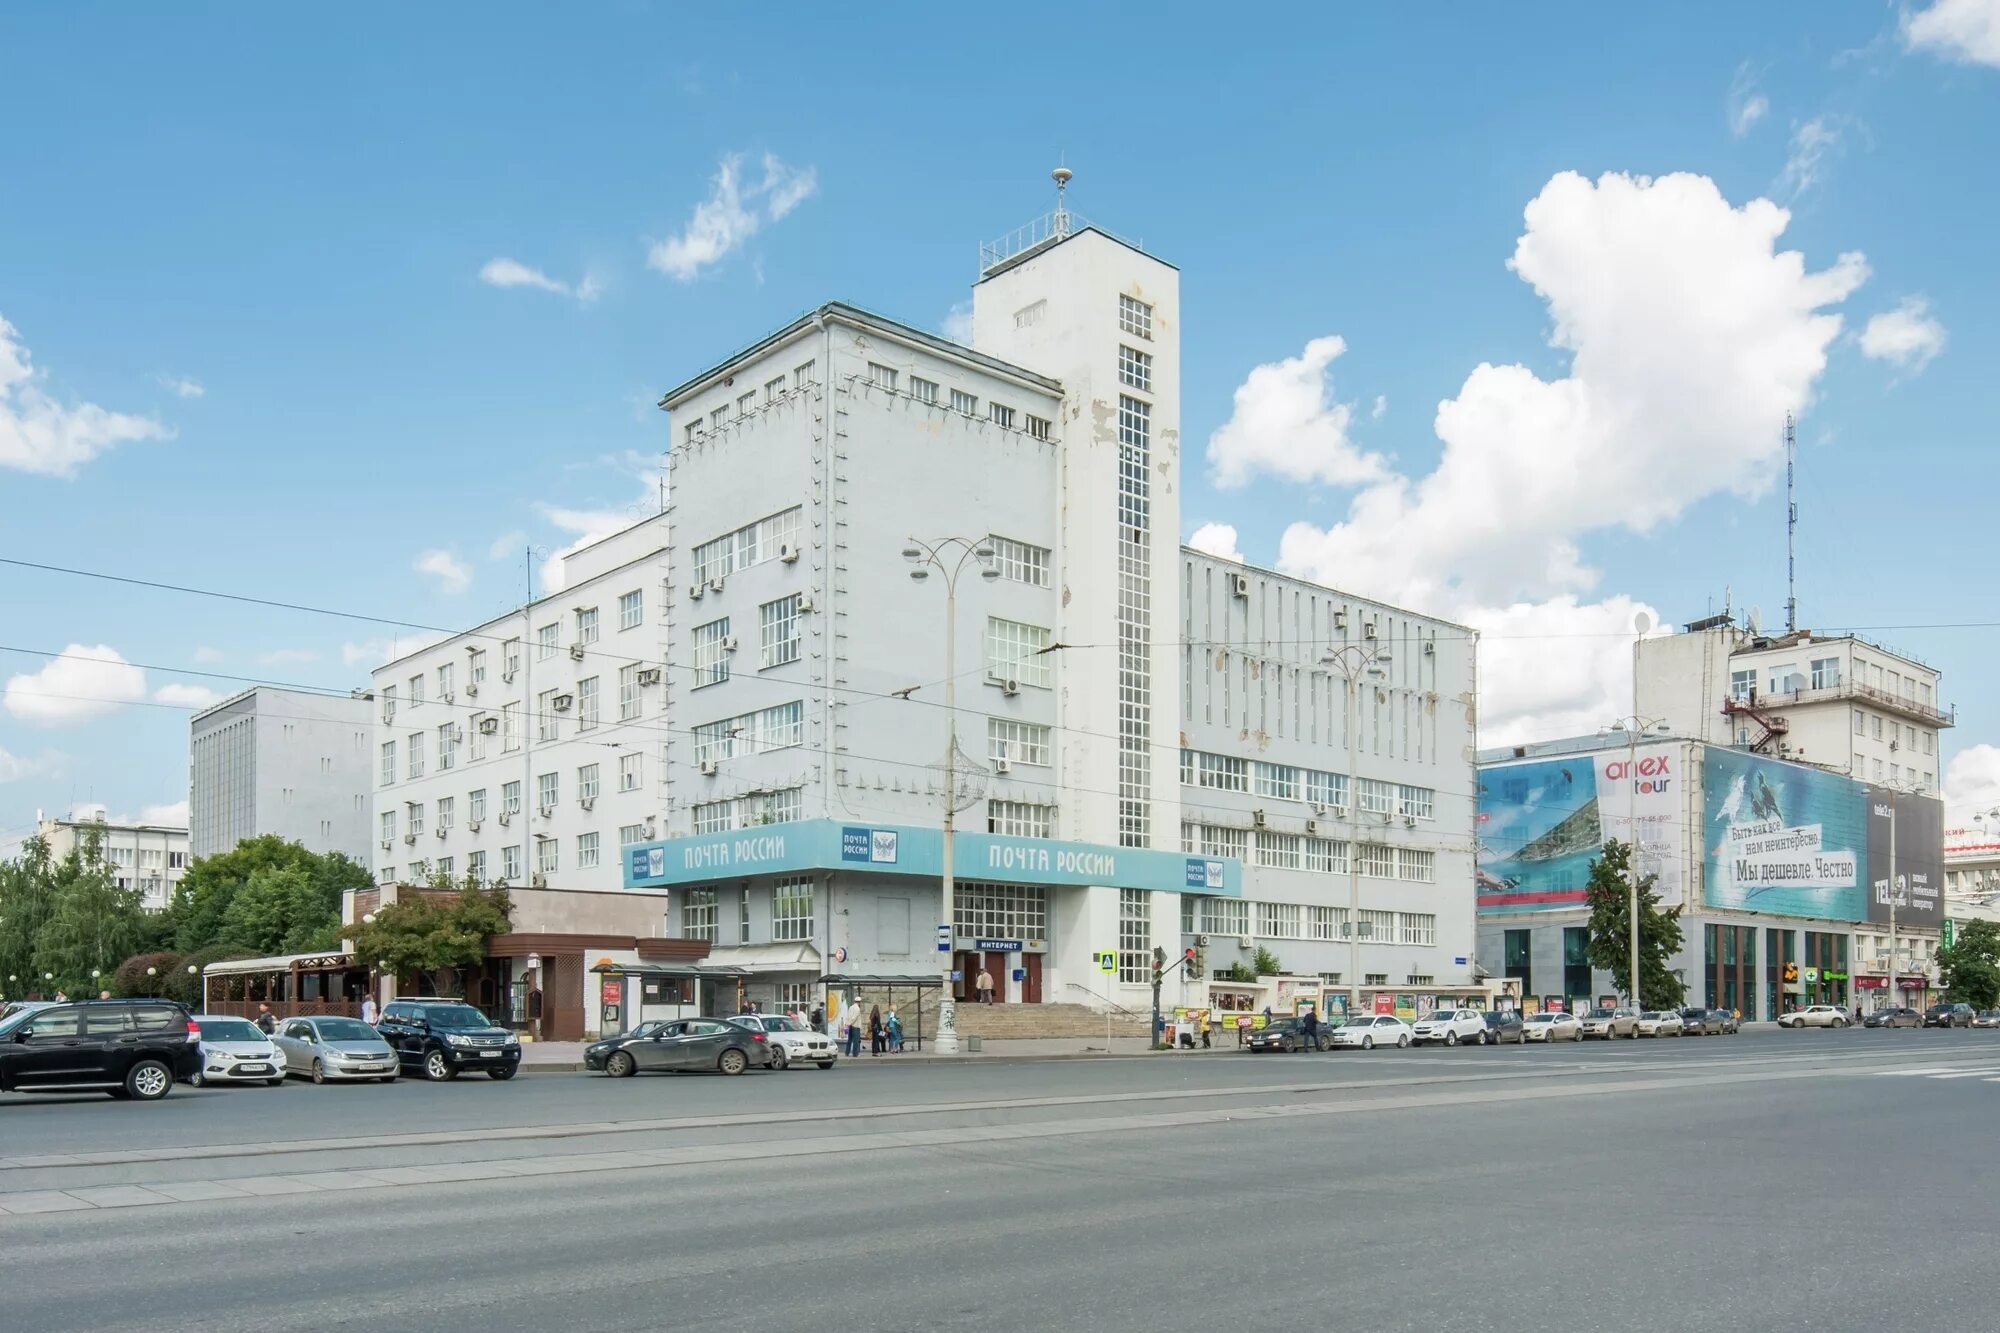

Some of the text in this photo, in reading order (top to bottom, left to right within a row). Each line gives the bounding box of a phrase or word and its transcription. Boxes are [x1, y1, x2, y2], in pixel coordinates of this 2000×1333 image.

[1605, 755, 1670, 780] anex
[1635, 779, 1670, 795] tour
[1732, 821, 1781, 841] Быть как все
[844, 834, 868, 845] ПОЧТА
[1746, 833, 1820, 855] нам неинтересно.
[684, 835, 785, 869] ПОЧТА РОССИИ
[844, 844, 868, 855] РОССИИ
[633, 855, 648, 865] ПОЧТА
[989, 845, 1115, 876] ПОЧТА РОССИИ
[633, 864, 648, 873] РОССИИ
[1187, 864, 1204, 873] ПОЧТА
[1187, 872, 1204, 881] РОССИИ
[1736, 858, 1853, 884] Мы дешевле. Честно
[1875, 874, 1907, 906] TEL2
[981, 941, 1018, 950] ИНТЕРНЕТ
